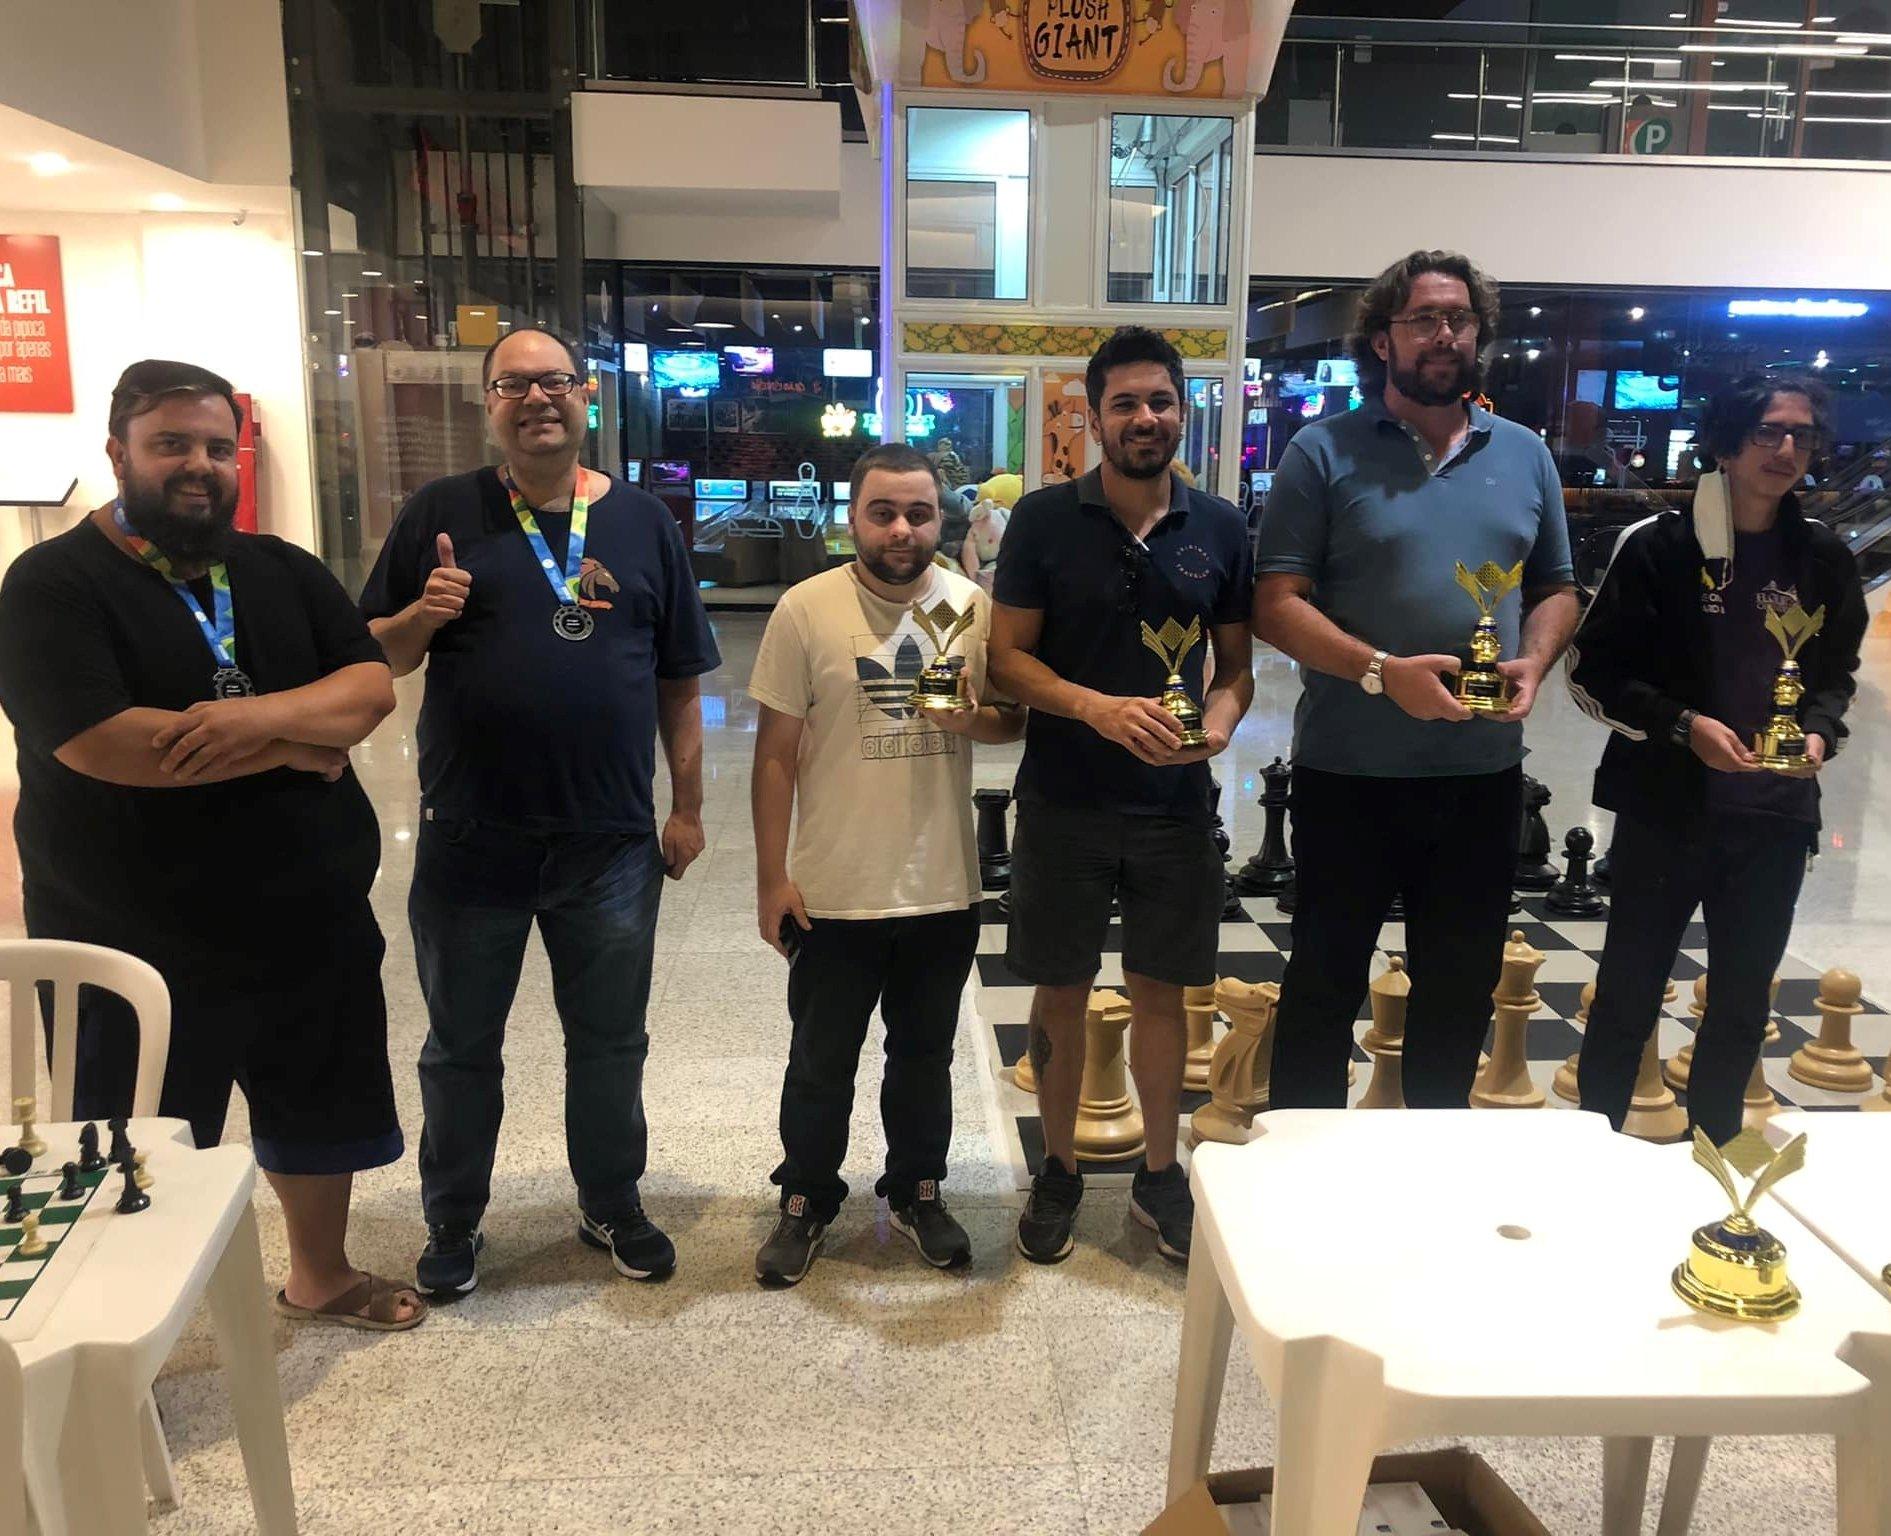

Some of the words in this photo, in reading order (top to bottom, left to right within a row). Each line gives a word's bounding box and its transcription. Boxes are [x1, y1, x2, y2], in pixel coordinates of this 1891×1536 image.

[1047, 0, 1109, 20] PLUSH
[1034, 22, 1119, 60] GIANT
[1646, 125, 1666, 153] P
[6, 289, 52, 314] REFIL
